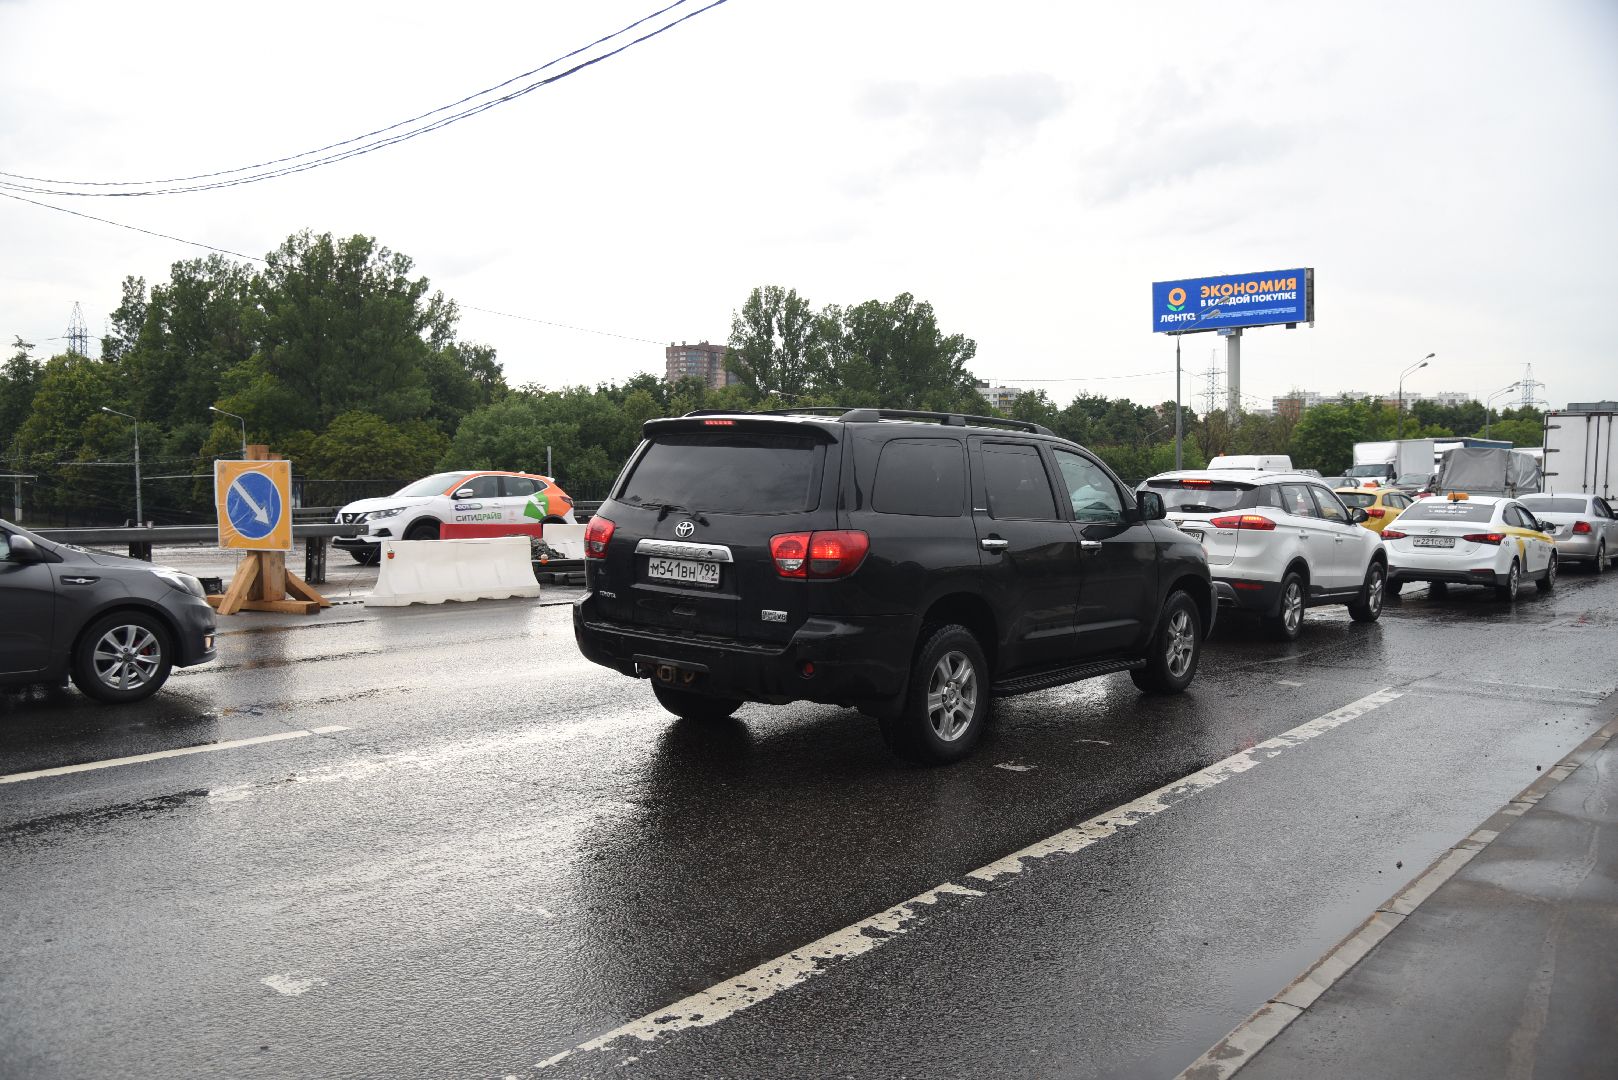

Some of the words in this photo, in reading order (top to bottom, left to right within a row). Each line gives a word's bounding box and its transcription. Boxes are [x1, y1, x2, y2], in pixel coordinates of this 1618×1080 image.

[1201, 278, 1297, 298] ЭКОНОМИЯ
[1200, 299, 1207, 307] В
[1252, 291, 1297, 303] ПОКУПКЕ
[1160, 312, 1196, 323] лента
[456, 512, 502, 521] СИТИДРАЙВ
[698, 562, 717, 577] 799
